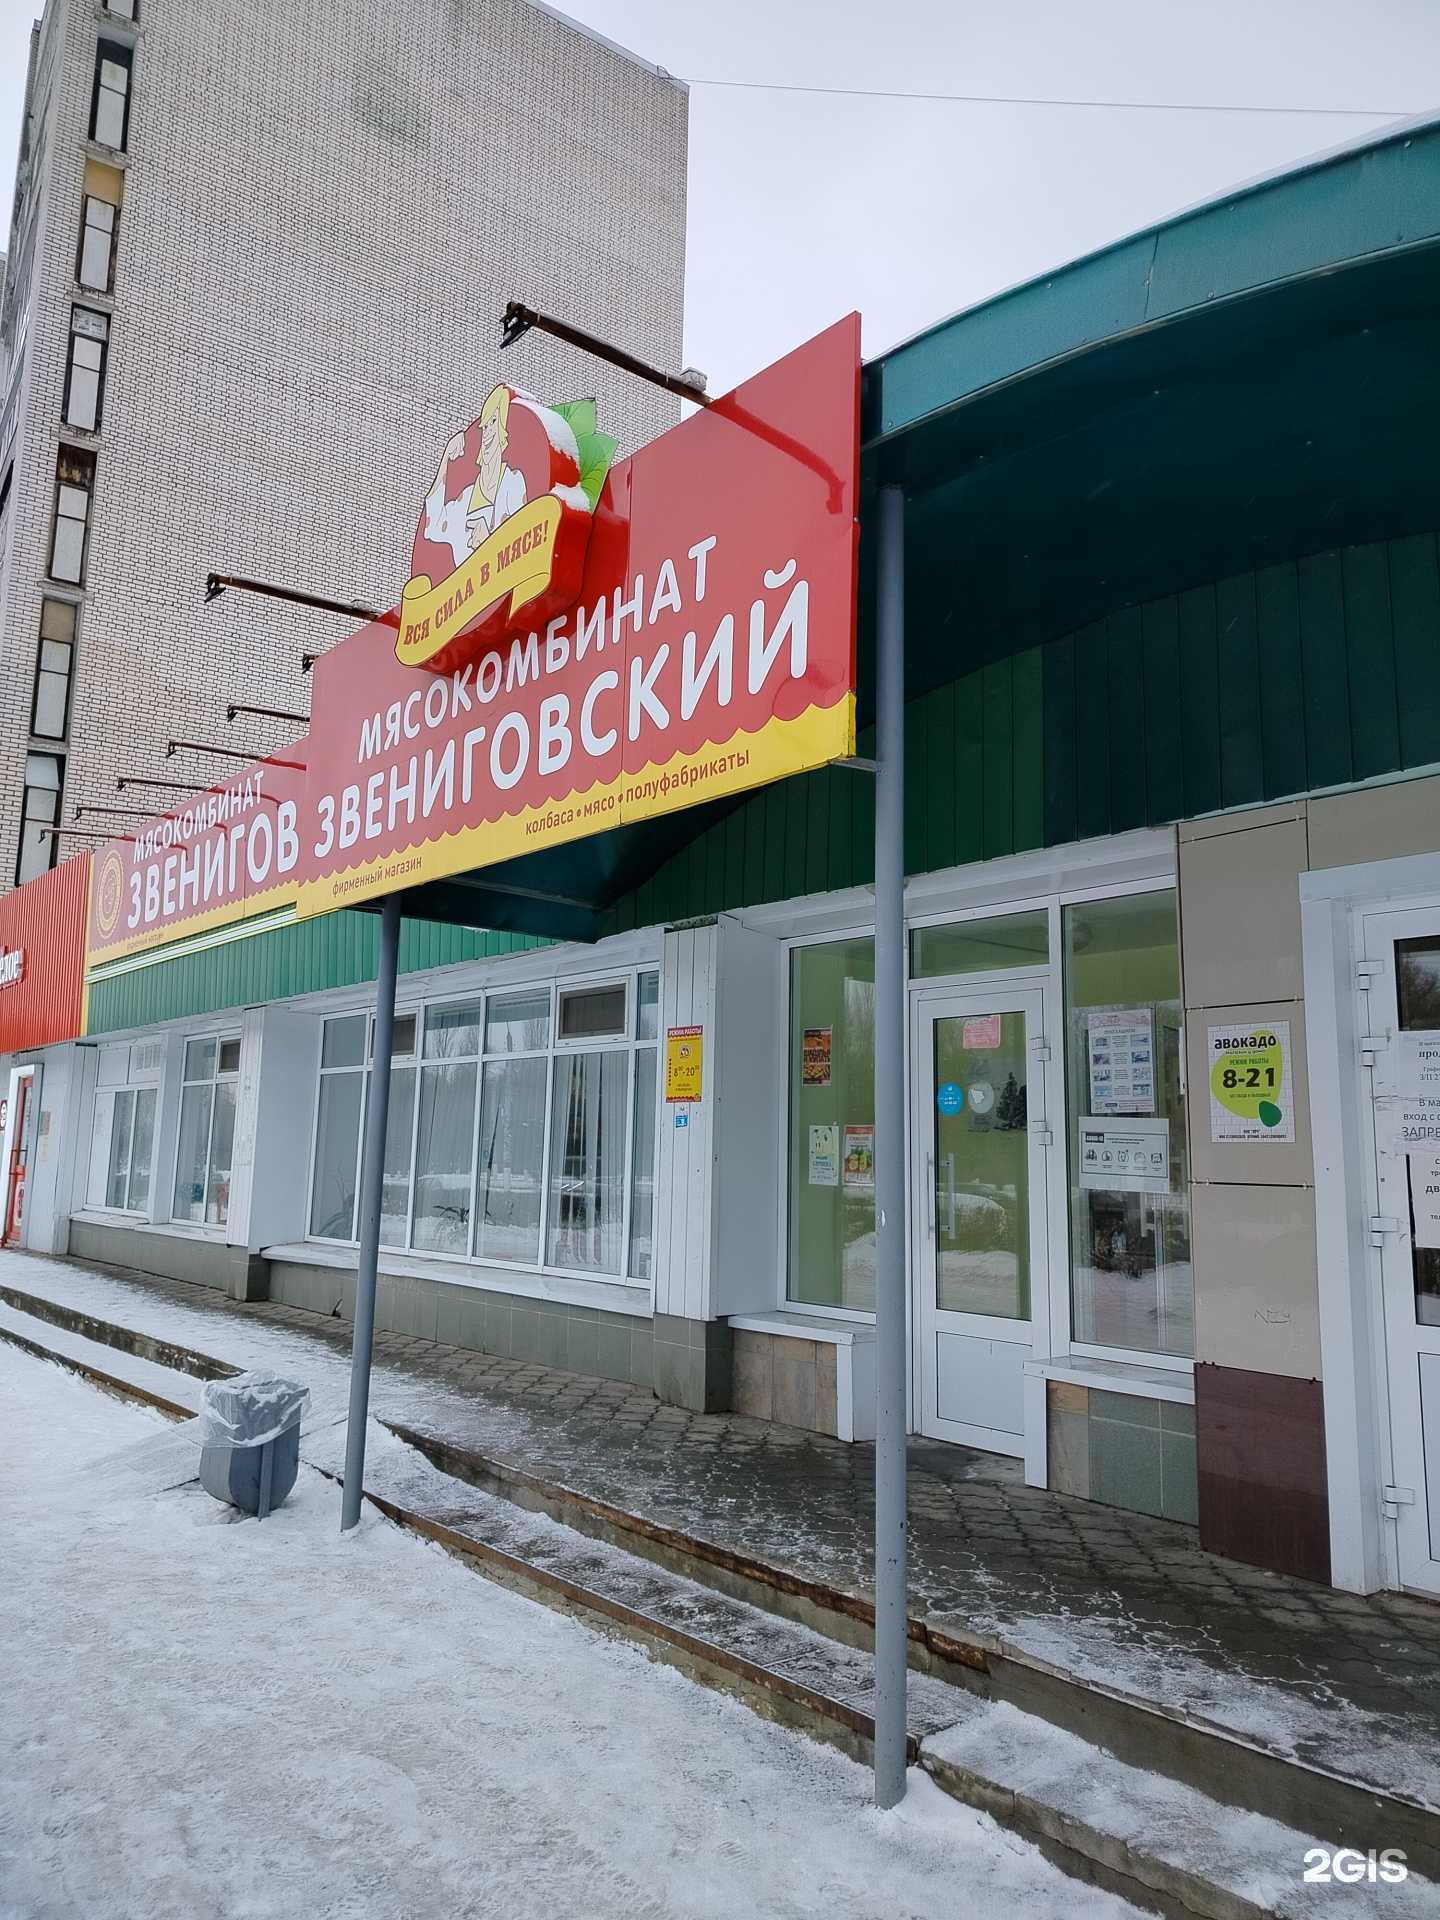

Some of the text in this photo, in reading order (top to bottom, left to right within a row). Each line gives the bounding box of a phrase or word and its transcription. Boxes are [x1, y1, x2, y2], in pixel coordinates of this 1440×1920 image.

[404, 520, 549, 645] ВСЯ СИЛА В МЯСЕ!
[358, 535, 717, 764] МЯСОКОМБИНАТ
[314, 559, 809, 858] ЗВЕНИГОВСКИЙ
[133, 770, 264, 864] МЯСОКОМБИНАТ
[525, 749, 751, 836] колбаса мясо полуфабрикаты
[127, 800, 300, 928] ЗВЕНИГОВ
[332, 857, 422, 898] фирменный магазин
[1214, 1035, 1277, 1050] авокадо
[1419, 1051, 1440, 1060] про
[1222, 1067, 1275, 1088] 8-21
[1428, 1099, 1440, 1107] ма
[1401, 1126, 1440, 1137] ЗАПРЕ
